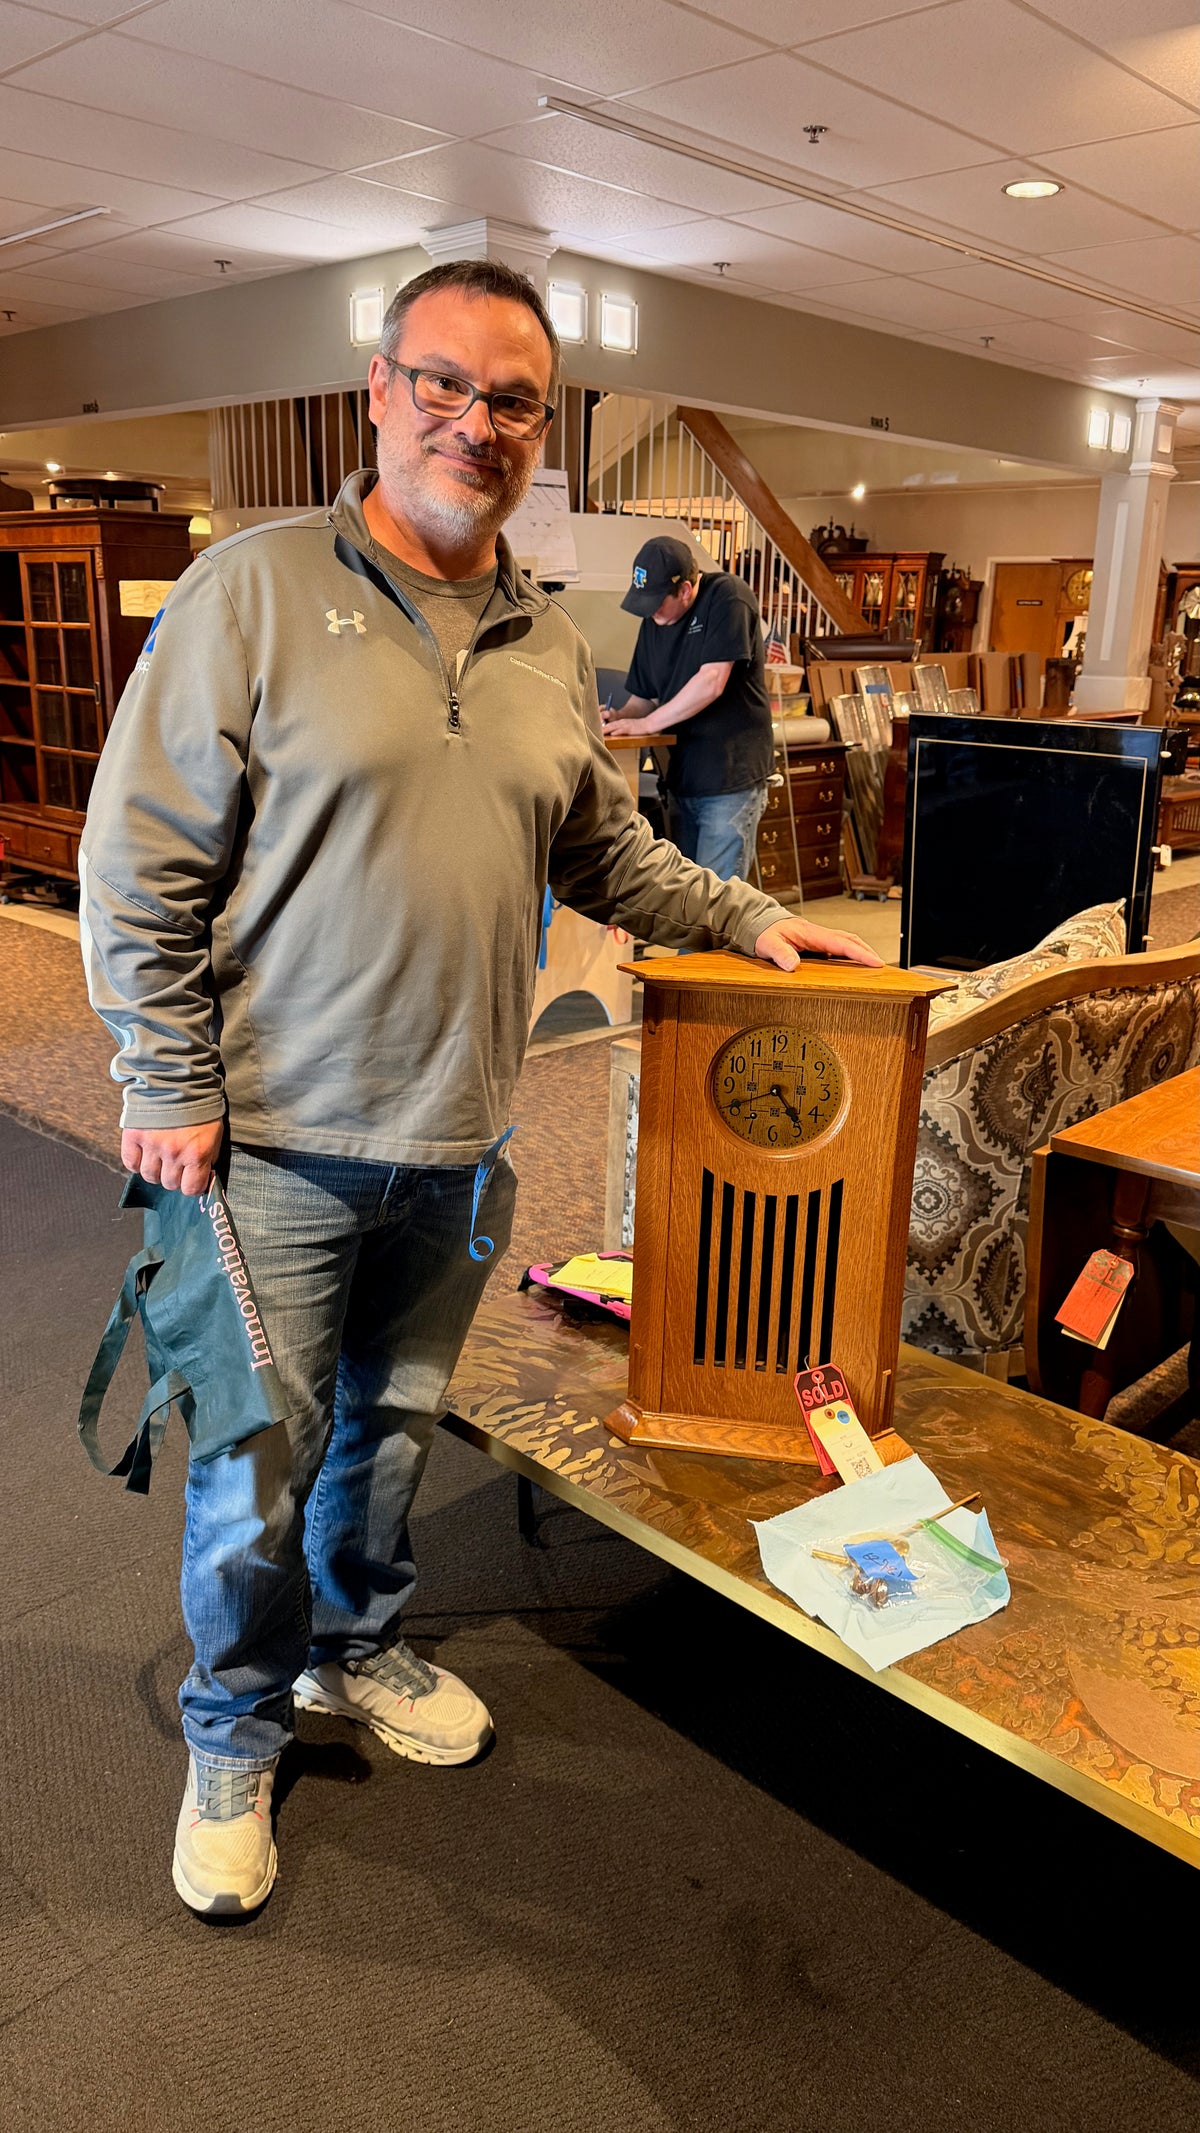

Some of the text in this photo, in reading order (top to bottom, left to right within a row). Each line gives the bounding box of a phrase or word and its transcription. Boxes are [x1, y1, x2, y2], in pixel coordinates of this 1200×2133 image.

[750, 1039, 762, 1057] 11
[771, 1034, 788, 1053] 12
[800, 1042, 807, 1061] 1
[729, 1055, 746, 1074] 10
[814, 1060, 826, 1080] 2
[723, 1076, 735, 1094] 9
[818, 1083, 831, 1101] 3
[807, 1106, 825, 1124] 4
[768, 1125, 778, 1143] 6
[1087, 1262, 1124, 1288] SOLD
[801, 1380, 844, 1408] SOLD
